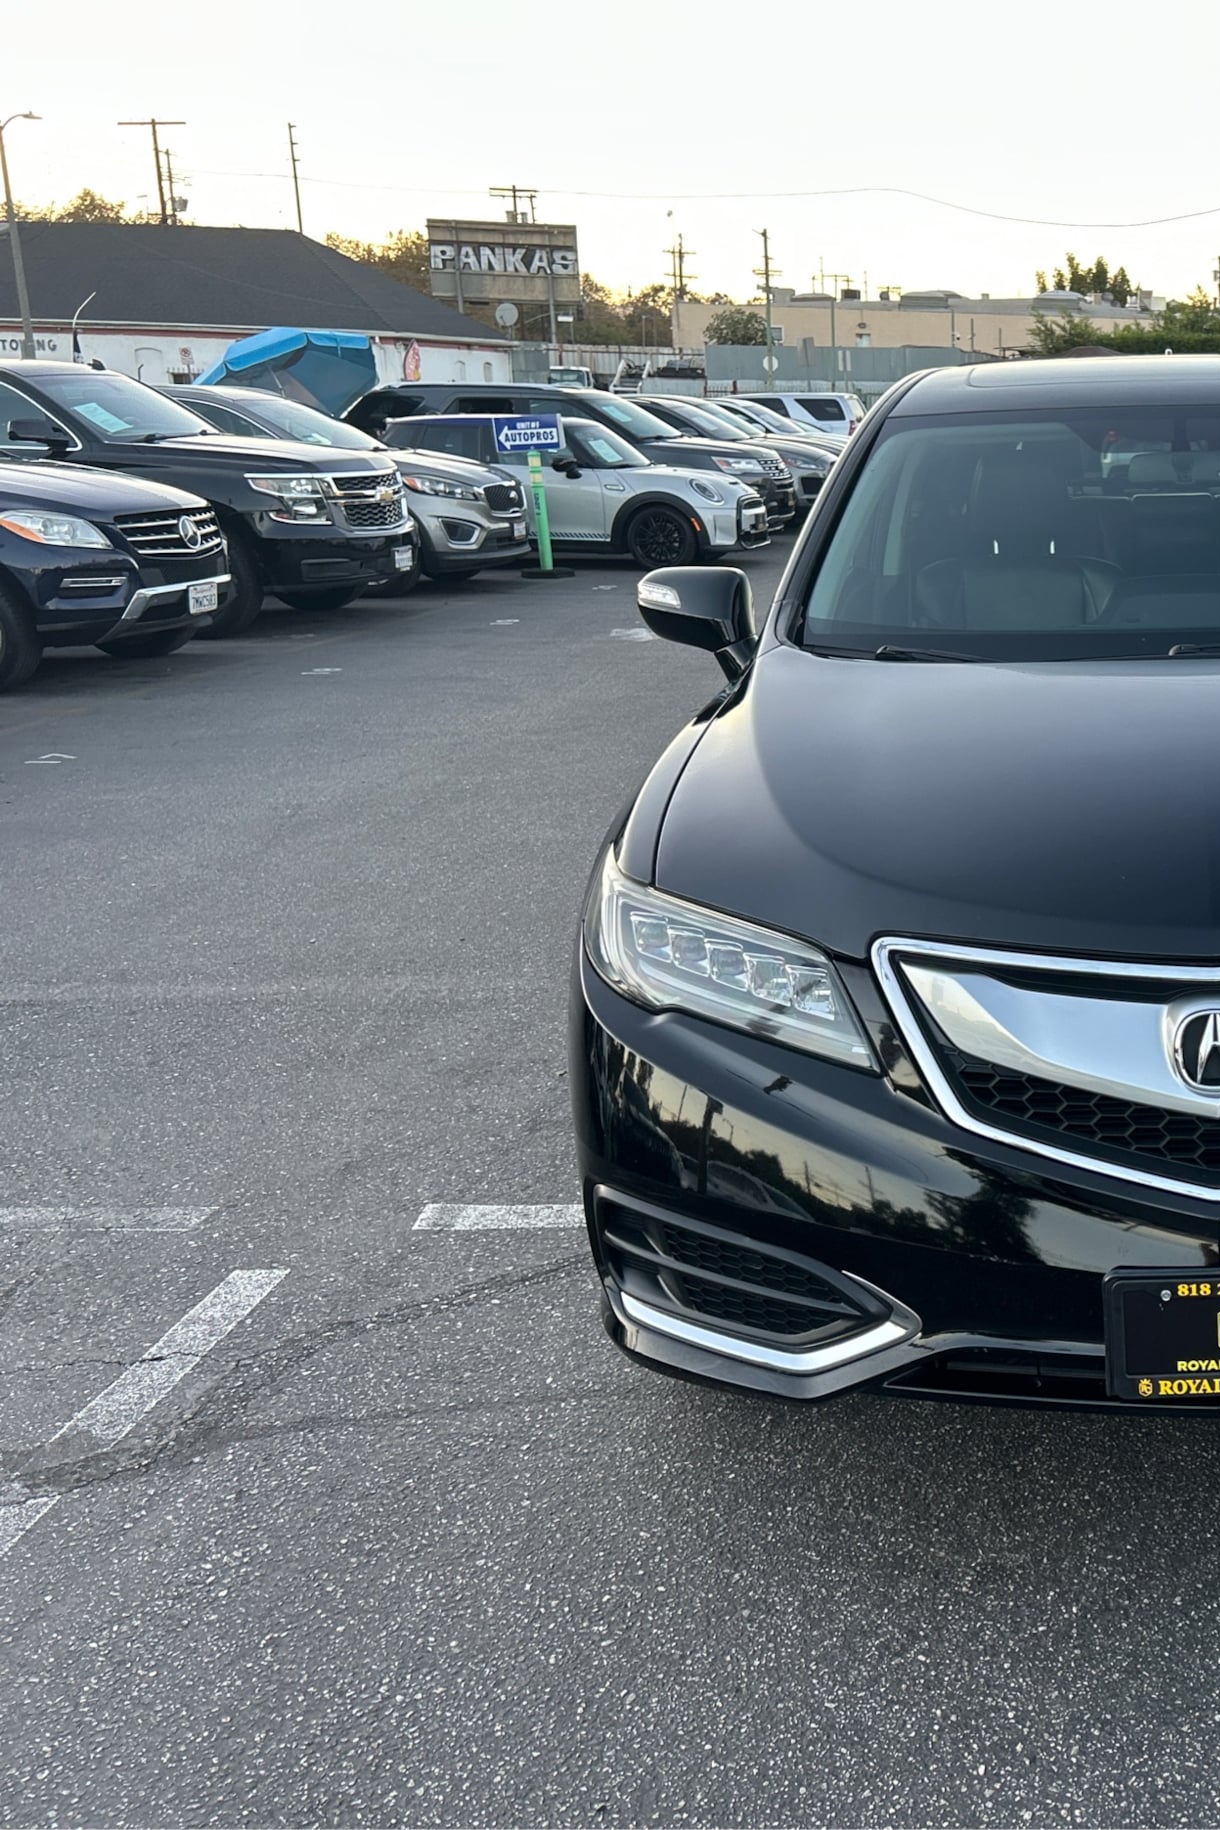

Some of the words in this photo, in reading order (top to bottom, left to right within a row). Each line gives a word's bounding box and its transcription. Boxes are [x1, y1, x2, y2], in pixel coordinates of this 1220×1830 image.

[430, 243, 579, 276] PANKAS
[0, 338, 58, 352] TONG
[504, 430, 555, 443] AUTOPROS
[1177, 1283, 1212, 1297] 818
